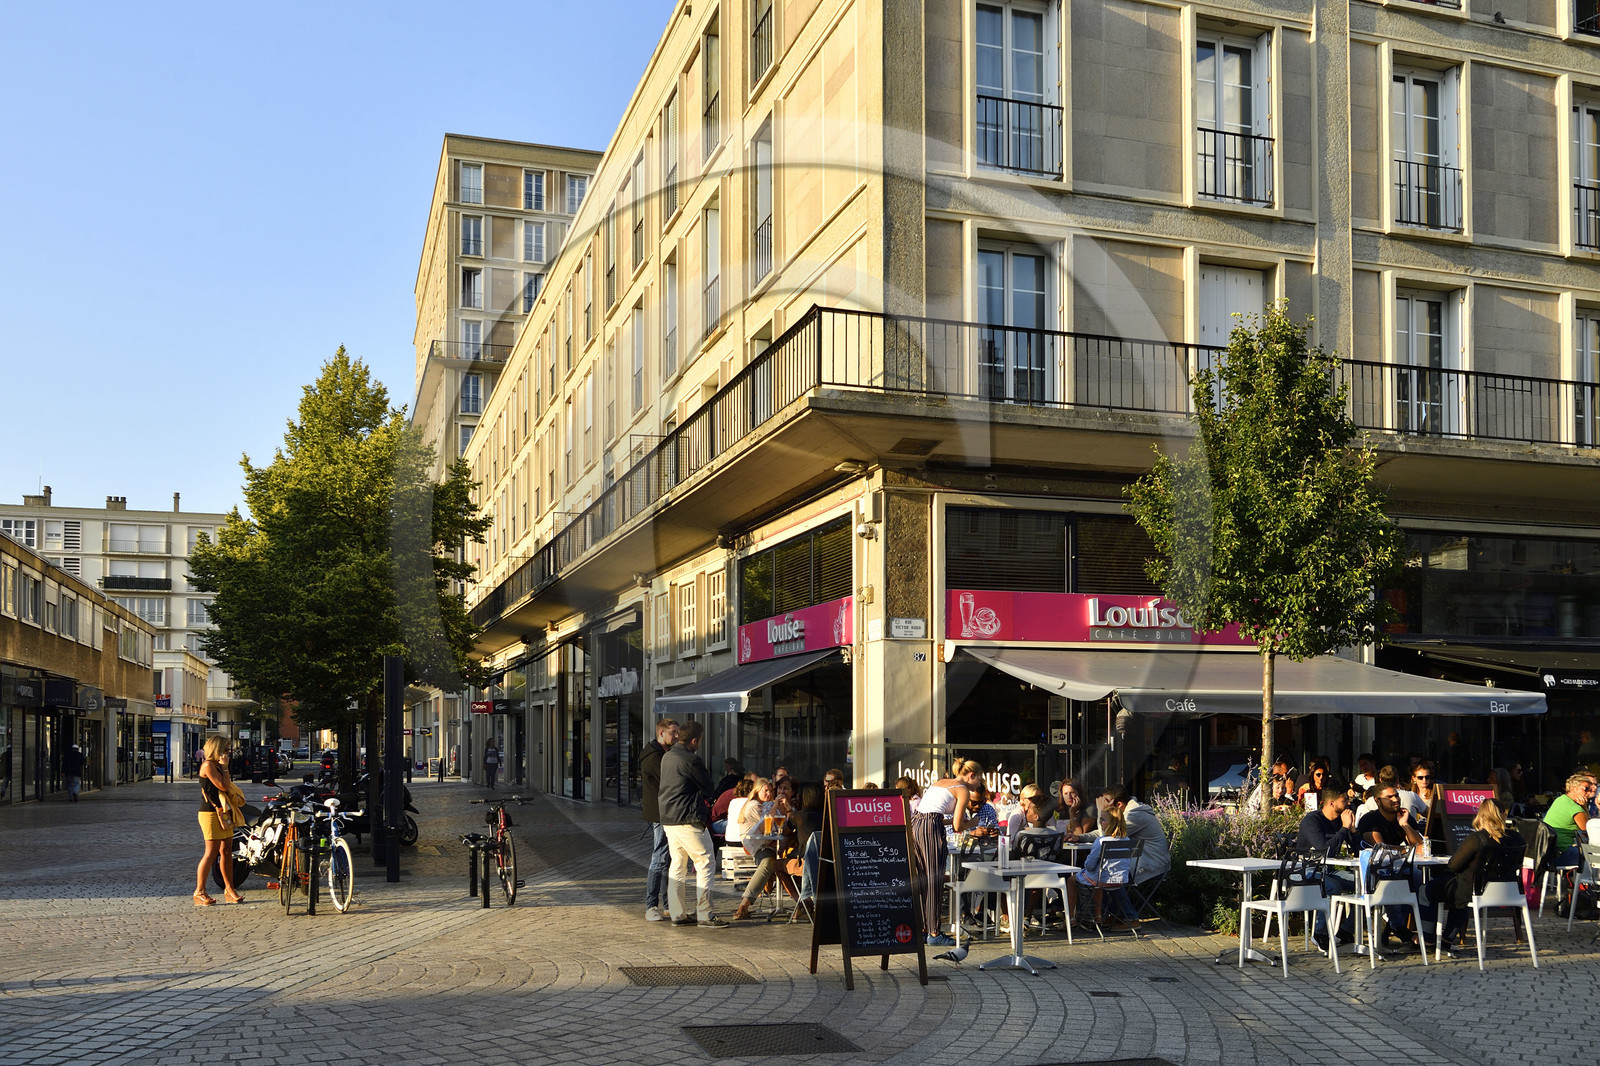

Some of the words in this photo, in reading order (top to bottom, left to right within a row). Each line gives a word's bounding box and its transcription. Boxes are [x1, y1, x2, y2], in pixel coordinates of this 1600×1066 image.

[914, 652, 926, 662] 87
[1165, 698, 1196, 711] Café
[1490, 701, 1510, 713] Bar
[873, 814, 892, 823] Café
